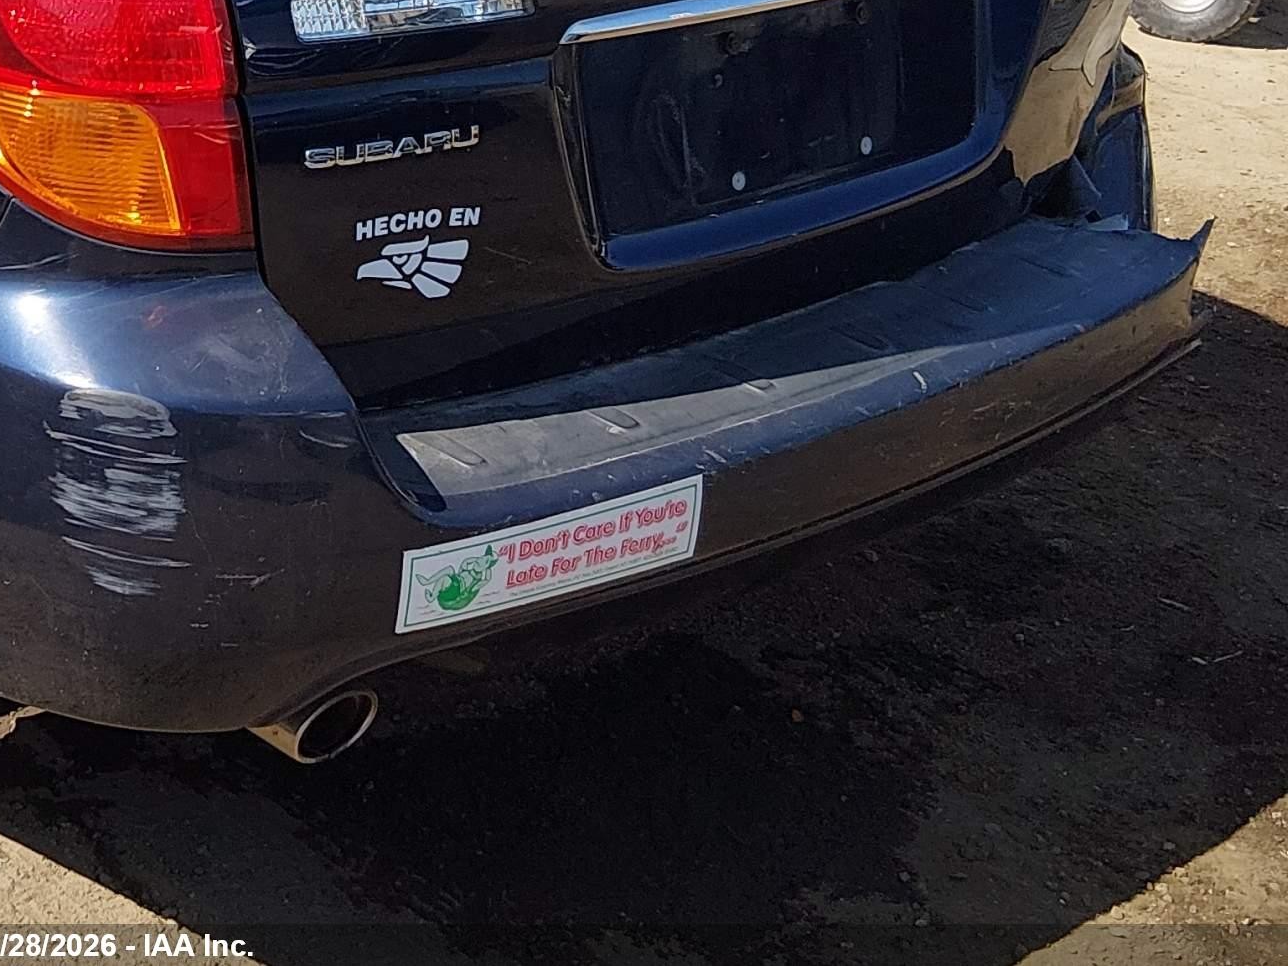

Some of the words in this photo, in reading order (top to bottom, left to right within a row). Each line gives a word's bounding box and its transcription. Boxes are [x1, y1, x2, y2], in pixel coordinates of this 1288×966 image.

[304, 125, 479, 169] SUBARU
[355, 209, 442, 241] HECHO
[449, 207, 481, 226] EN
[518, 529, 570, 561] Don't
[573, 521, 616, 546] Care
[618, 510, 633, 533] If
[634, 498, 688, 529] You're
[505, 564, 548, 589] Late
[550, 555, 581, 577] For
[585, 545, 617, 567] The
